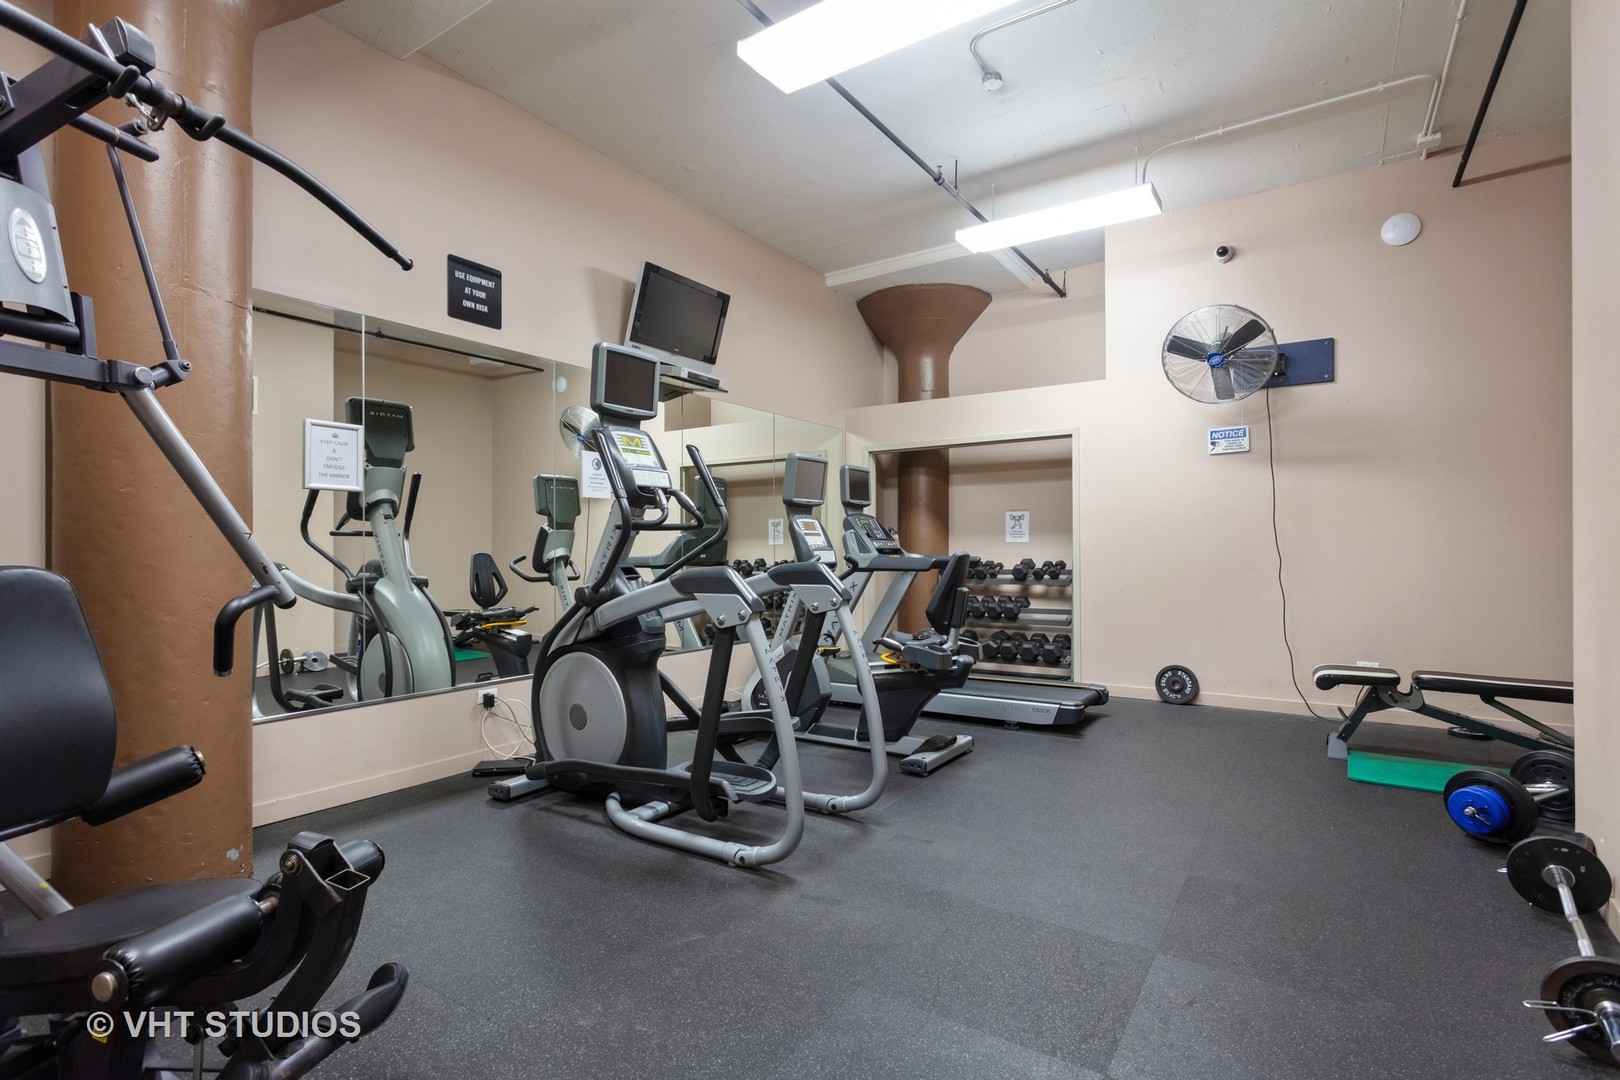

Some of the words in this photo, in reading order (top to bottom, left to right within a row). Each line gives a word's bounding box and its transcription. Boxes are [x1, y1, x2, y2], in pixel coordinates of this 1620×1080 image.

[455, 270, 465, 280] USE
[466, 274, 495, 289] EQUIPMENT
[472, 289, 487, 299] YOUR
[462, 300, 475, 310] OWN
[476, 303, 489, 313] RISK
[1211, 429, 1245, 440] NOTICE
[594, 528, 617, 580] MATRIX
[779, 592, 798, 637] MATRIX
[1178, 670, 1193, 695] STANDARD
